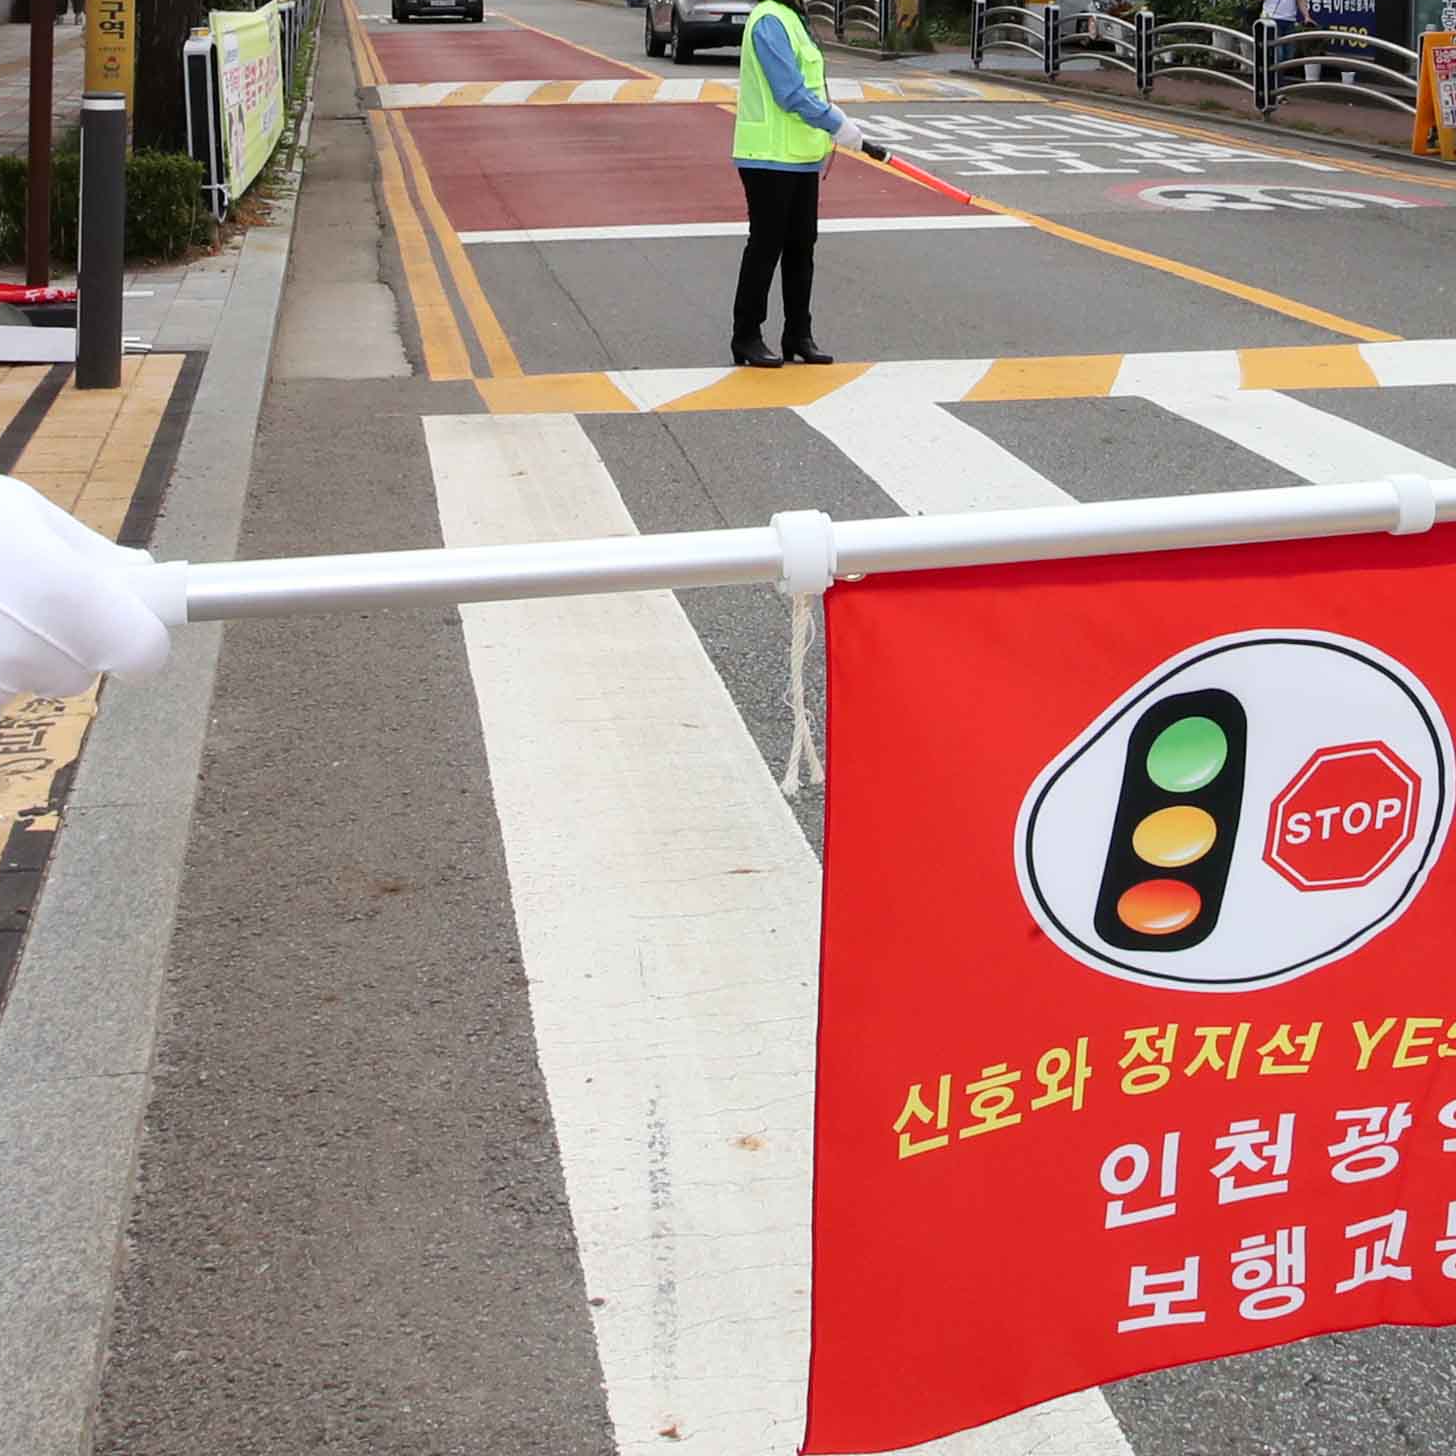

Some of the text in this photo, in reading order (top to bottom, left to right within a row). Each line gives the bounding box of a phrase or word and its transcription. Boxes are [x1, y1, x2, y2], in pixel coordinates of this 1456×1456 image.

[1285, 791, 1404, 851] STOP
[891, 1037, 1093, 1161] 신호와
[1117, 1020, 1324, 1096] 정지선
